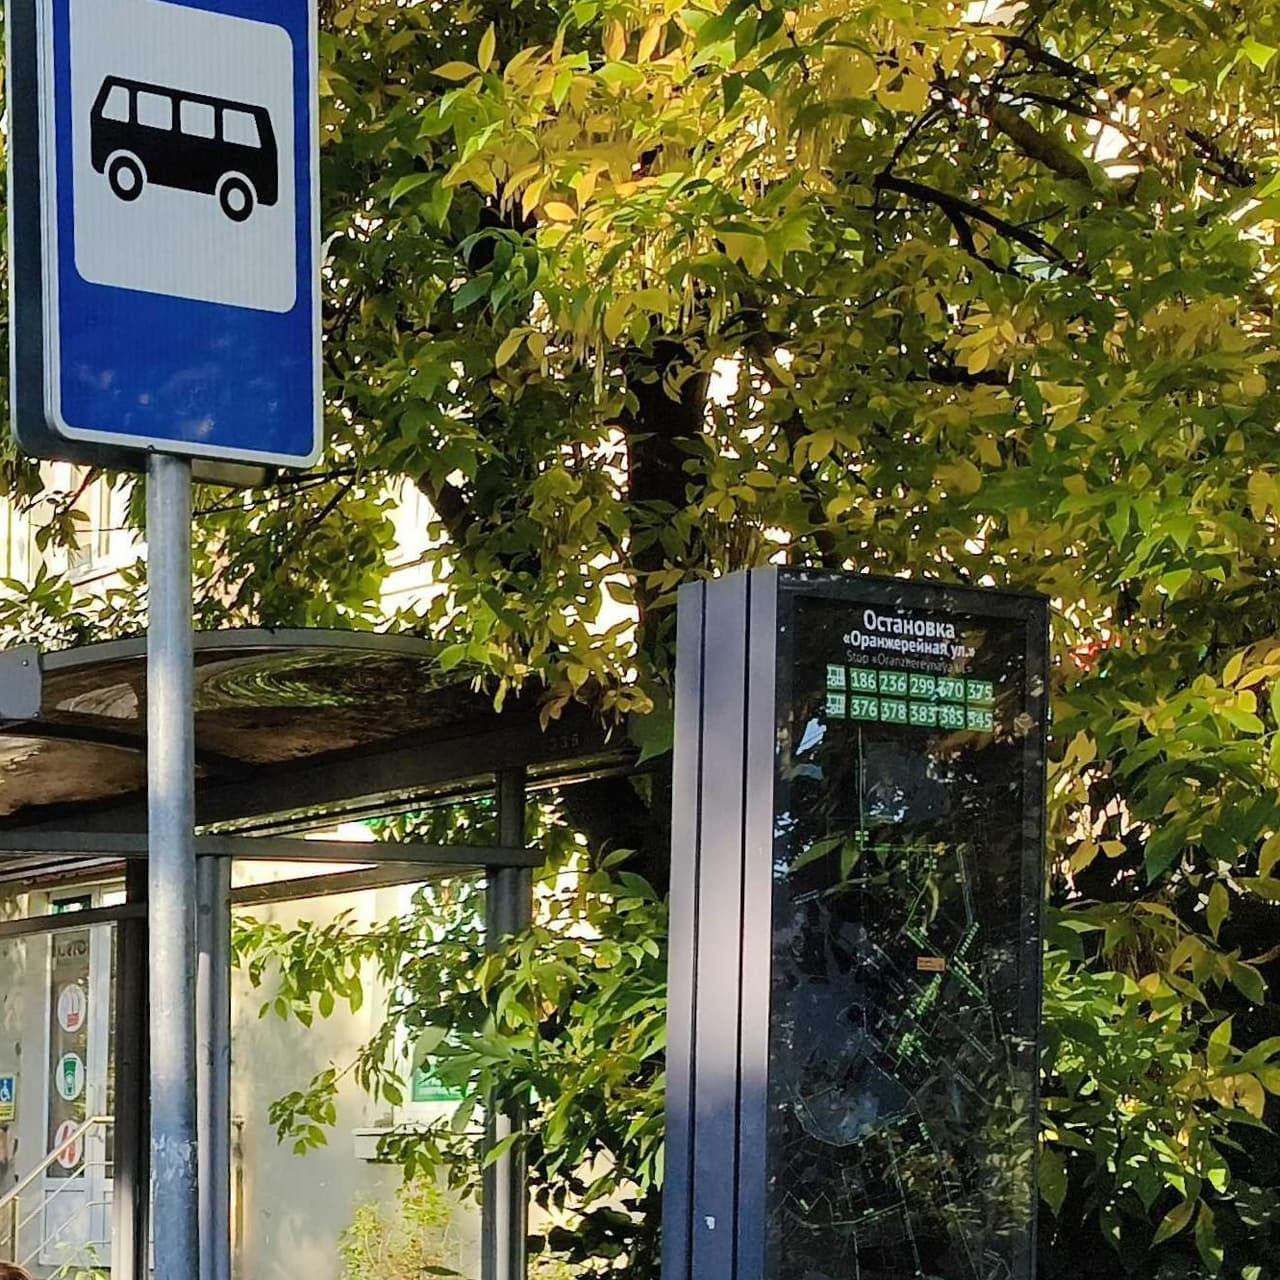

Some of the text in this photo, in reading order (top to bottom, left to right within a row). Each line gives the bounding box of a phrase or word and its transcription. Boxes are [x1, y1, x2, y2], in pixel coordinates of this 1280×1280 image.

[863, 608, 956, 639] Остановка
[843, 630, 948, 656] «Оранжерейная
[846, 650, 869, 664] Stop
[850, 671, 877, 690] 186
[879, 674, 907, 692] 236
[910, 677, 935, 695] 299
[851, 699, 878, 717] 376
[881, 702, 907, 720] 378
[910, 704, 937, 723] 383
[939, 705, 965, 726] 385
